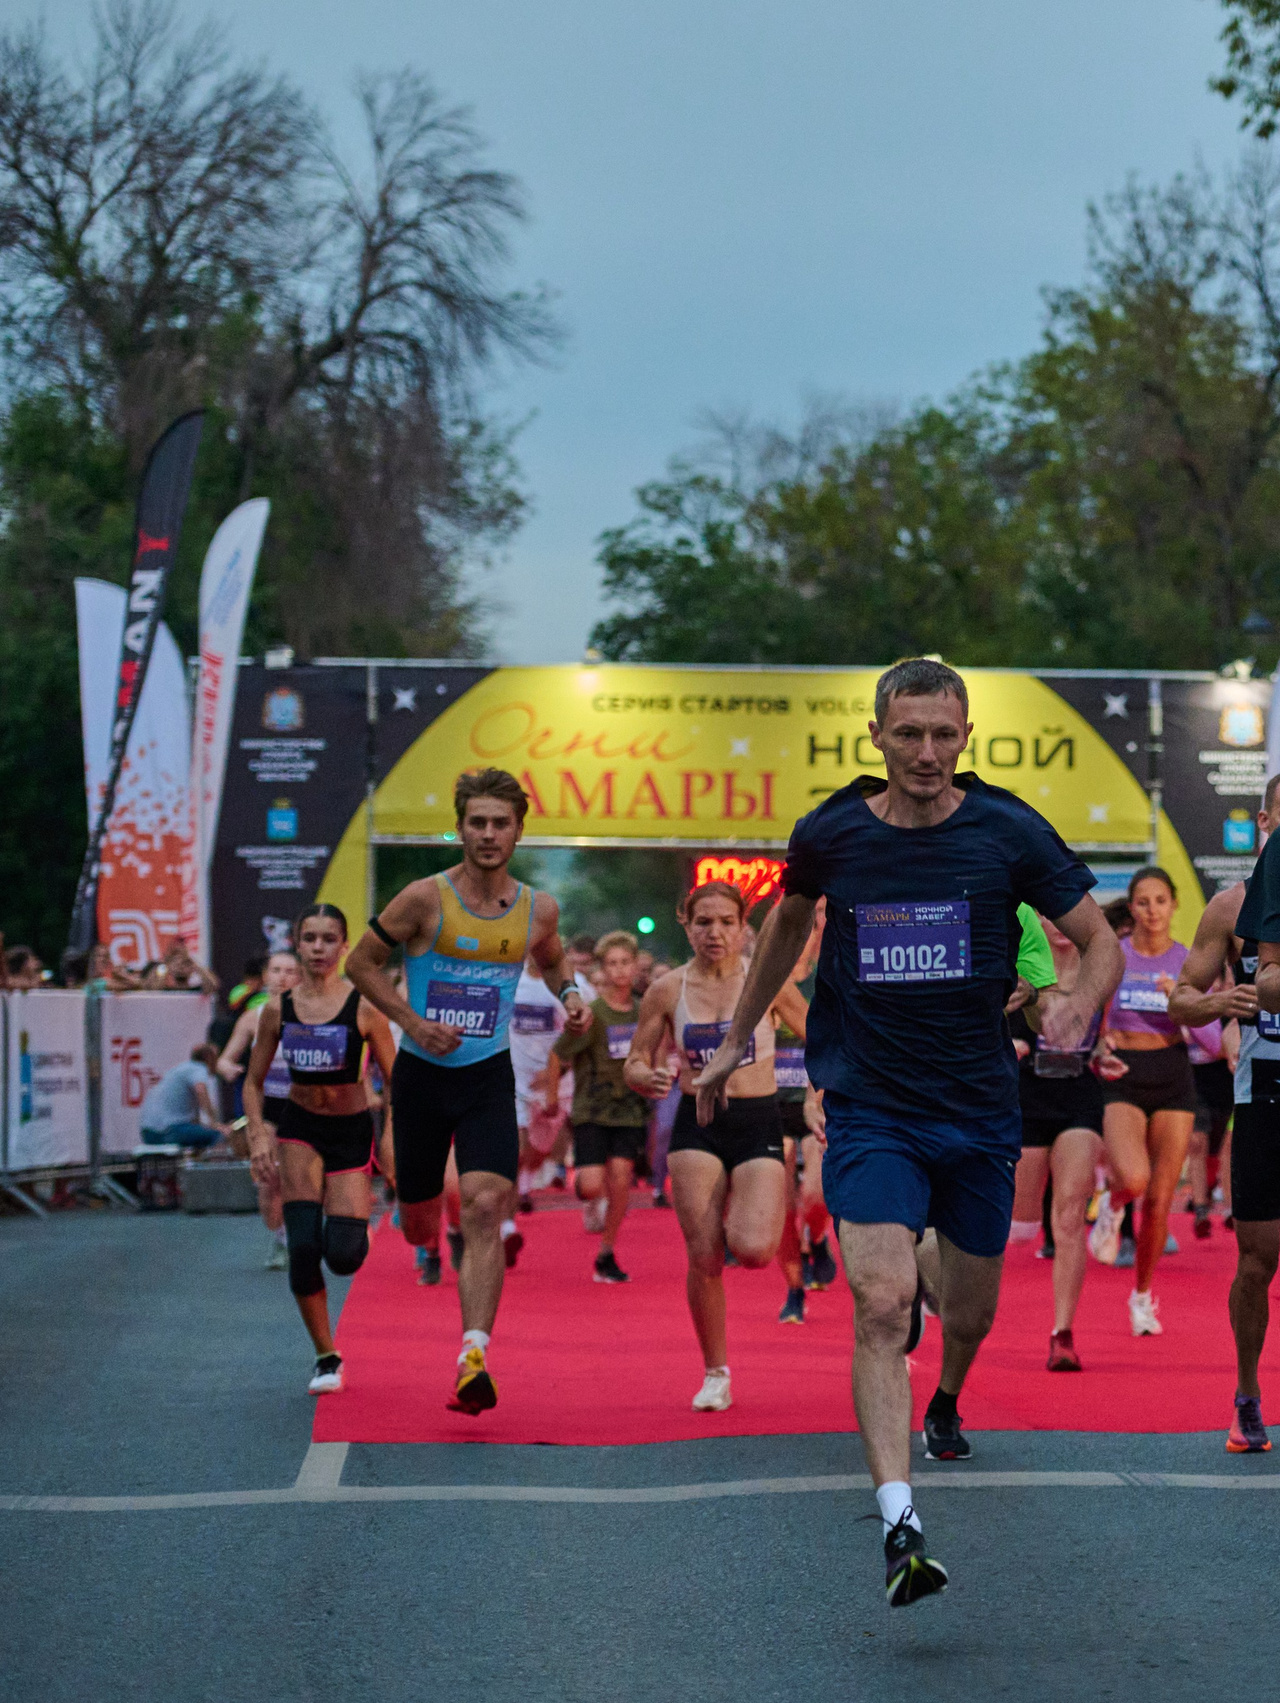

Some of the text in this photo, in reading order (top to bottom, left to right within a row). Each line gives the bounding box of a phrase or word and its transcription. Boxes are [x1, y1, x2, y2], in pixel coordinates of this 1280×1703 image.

[592, 694, 672, 713] СЕРИЯ
[679, 695, 791, 714] СТАРТОВ
[469, 700, 697, 762] Огни
[455, 765, 778, 820] АМАРЫ
[866, 912, 910, 922] САМАРЫ
[914, 905, 953, 914] НОЧНОЙ
[915, 913, 945, 921] ЗАБЕГ
[880, 944, 948, 972] 10102
[438, 1008, 486, 1029] 10087
[293, 1049, 332, 1066] 10184
